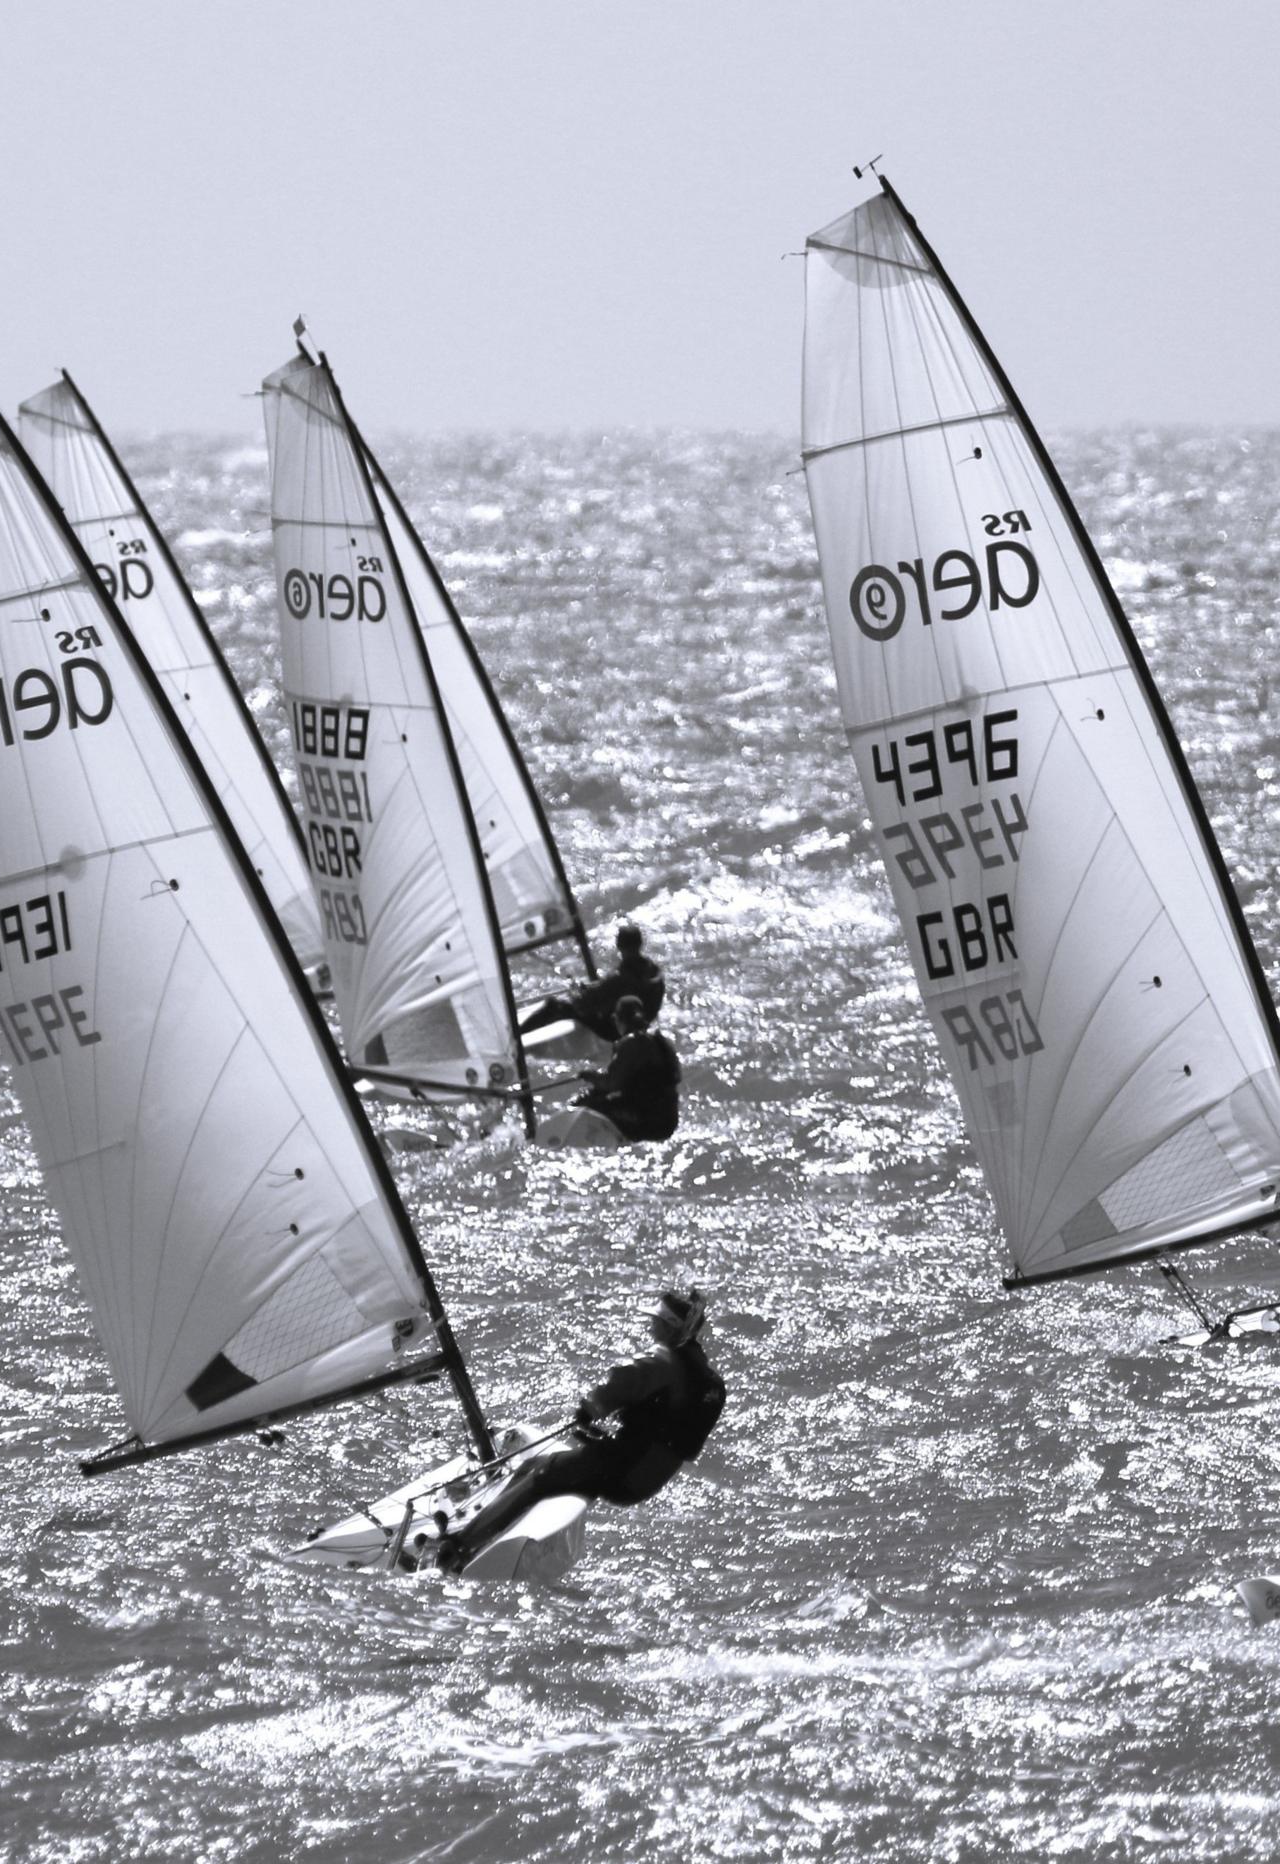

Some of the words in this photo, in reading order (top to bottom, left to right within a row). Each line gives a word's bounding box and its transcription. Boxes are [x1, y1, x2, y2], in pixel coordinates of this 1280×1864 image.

[293, 702, 370, 760] 1888
[872, 709, 1018, 807] 4396
[309, 821, 362, 879] GBR
[916, 893, 1018, 980] GBR
